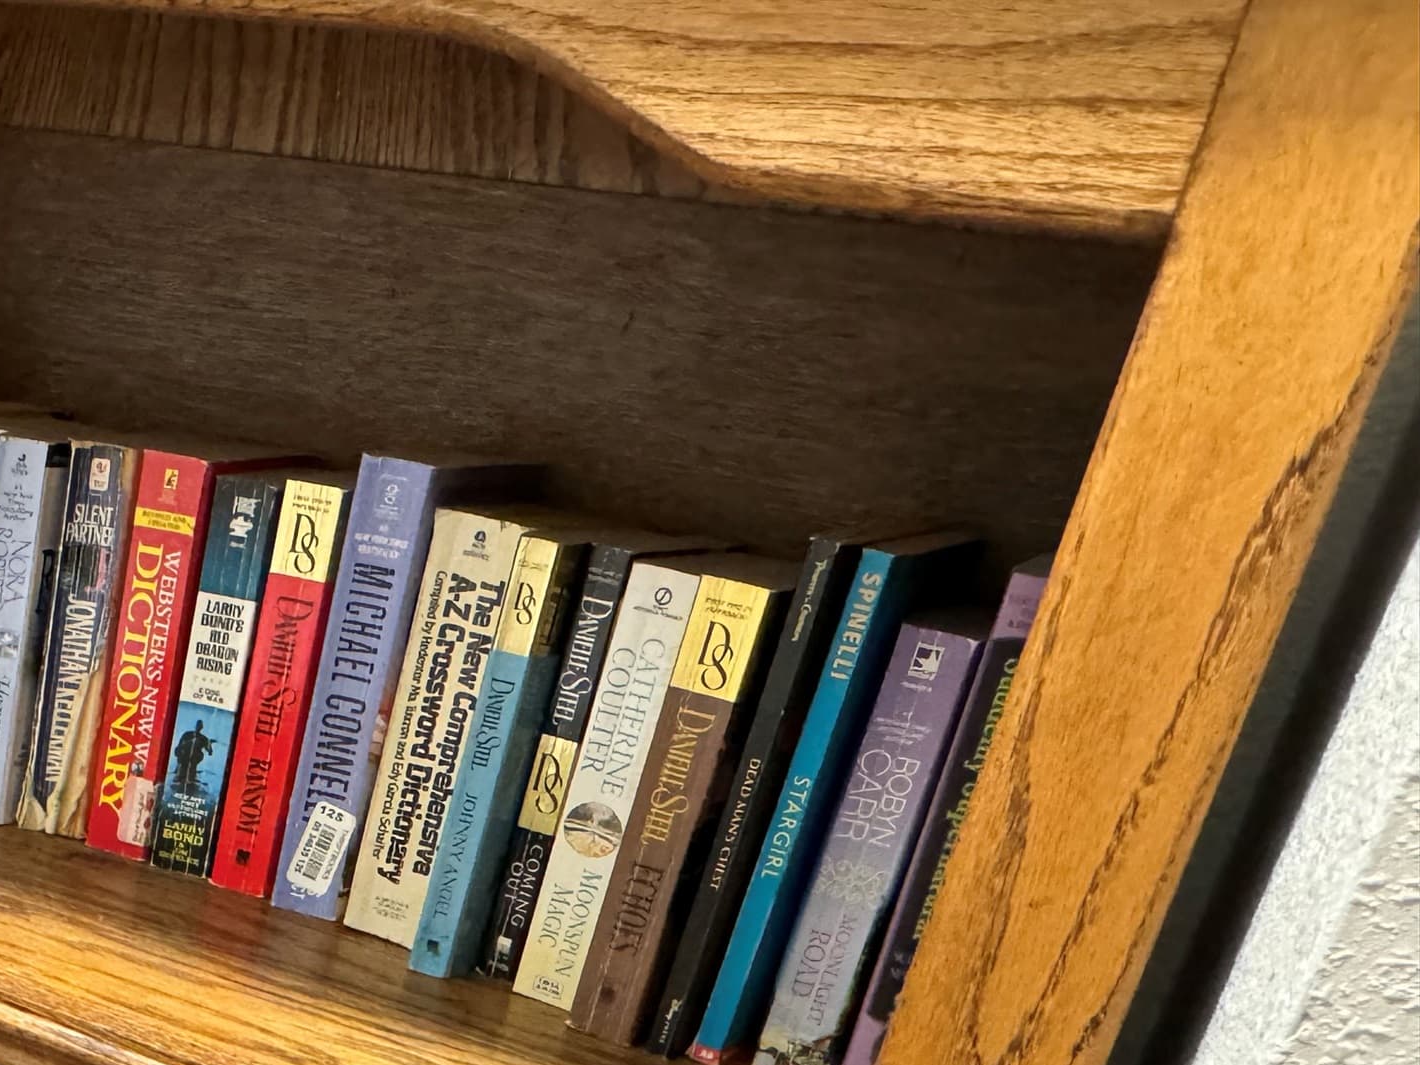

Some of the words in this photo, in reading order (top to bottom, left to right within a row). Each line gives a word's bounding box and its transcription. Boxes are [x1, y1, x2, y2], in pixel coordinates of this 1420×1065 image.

[73, 503, 114, 527] SILENT
[289, 513, 319, 574] DS
[3, 539, 33, 603] NORA
[424, 570, 448, 620] Compiled
[442, 574, 475, 618] A-Z
[470, 580, 505, 628] The
[57, 595, 97, 684] JONATHAN
[146, 547, 182, 678] WEBSTER'S
[268, 596, 314, 681] DANIELLE
[332, 561, 395, 684] MICHAEL
[421, 621, 438, 636] by
[561, 595, 614, 675] DANIELLE
[830, 571, 882, 681] SPINELLI
[97, 542, 163, 815] DICTIONARY
[456, 633, 493, 690] New
[697, 619, 735, 692] DS
[136, 683, 160, 739] NEW
[255, 680, 297, 744] STEEL
[409, 622, 464, 759] Crossword
[473, 678, 516, 737] DANIELLE
[550, 671, 593, 725] STEEL
[580, 646, 638, 774] COULTER
[600, 637, 667, 799] CATHERINE
[388, 763, 405, 782] Edy
[393, 741, 408, 761] and
[469, 733, 504, 771] STEEL
[660, 706, 716, 787] DANIELLE
[739, 758, 762, 798] DEAD
[236, 757, 268, 836] RANSOM
[381, 782, 399, 815] Garcia
[412, 692, 476, 877] Comprehensive
[639, 784, 690, 846] STEEL
[835, 749, 893, 843] CARR
[867, 757, 922, 849] ROBYN
[162, 827, 204, 846] BOND
[378, 765, 433, 885] Dictionary
[448, 793, 480, 863] JOHNNY
[725, 800, 748, 843] MAN'S
[760, 775, 812, 882] STARGIRL
[433, 864, 458, 920] ANGEL
[501, 861, 525, 907] OUT
[509, 845, 544, 928] COMING
[709, 846, 732, 891] CHEST
[536, 883, 575, 950] MAGIC
[553, 869, 604, 978] MOONSPUN
[608, 862, 665, 958] ECHOES
[790, 929, 831, 1000] ROAD
[804, 914, 859, 1028] MOONLIGHT
